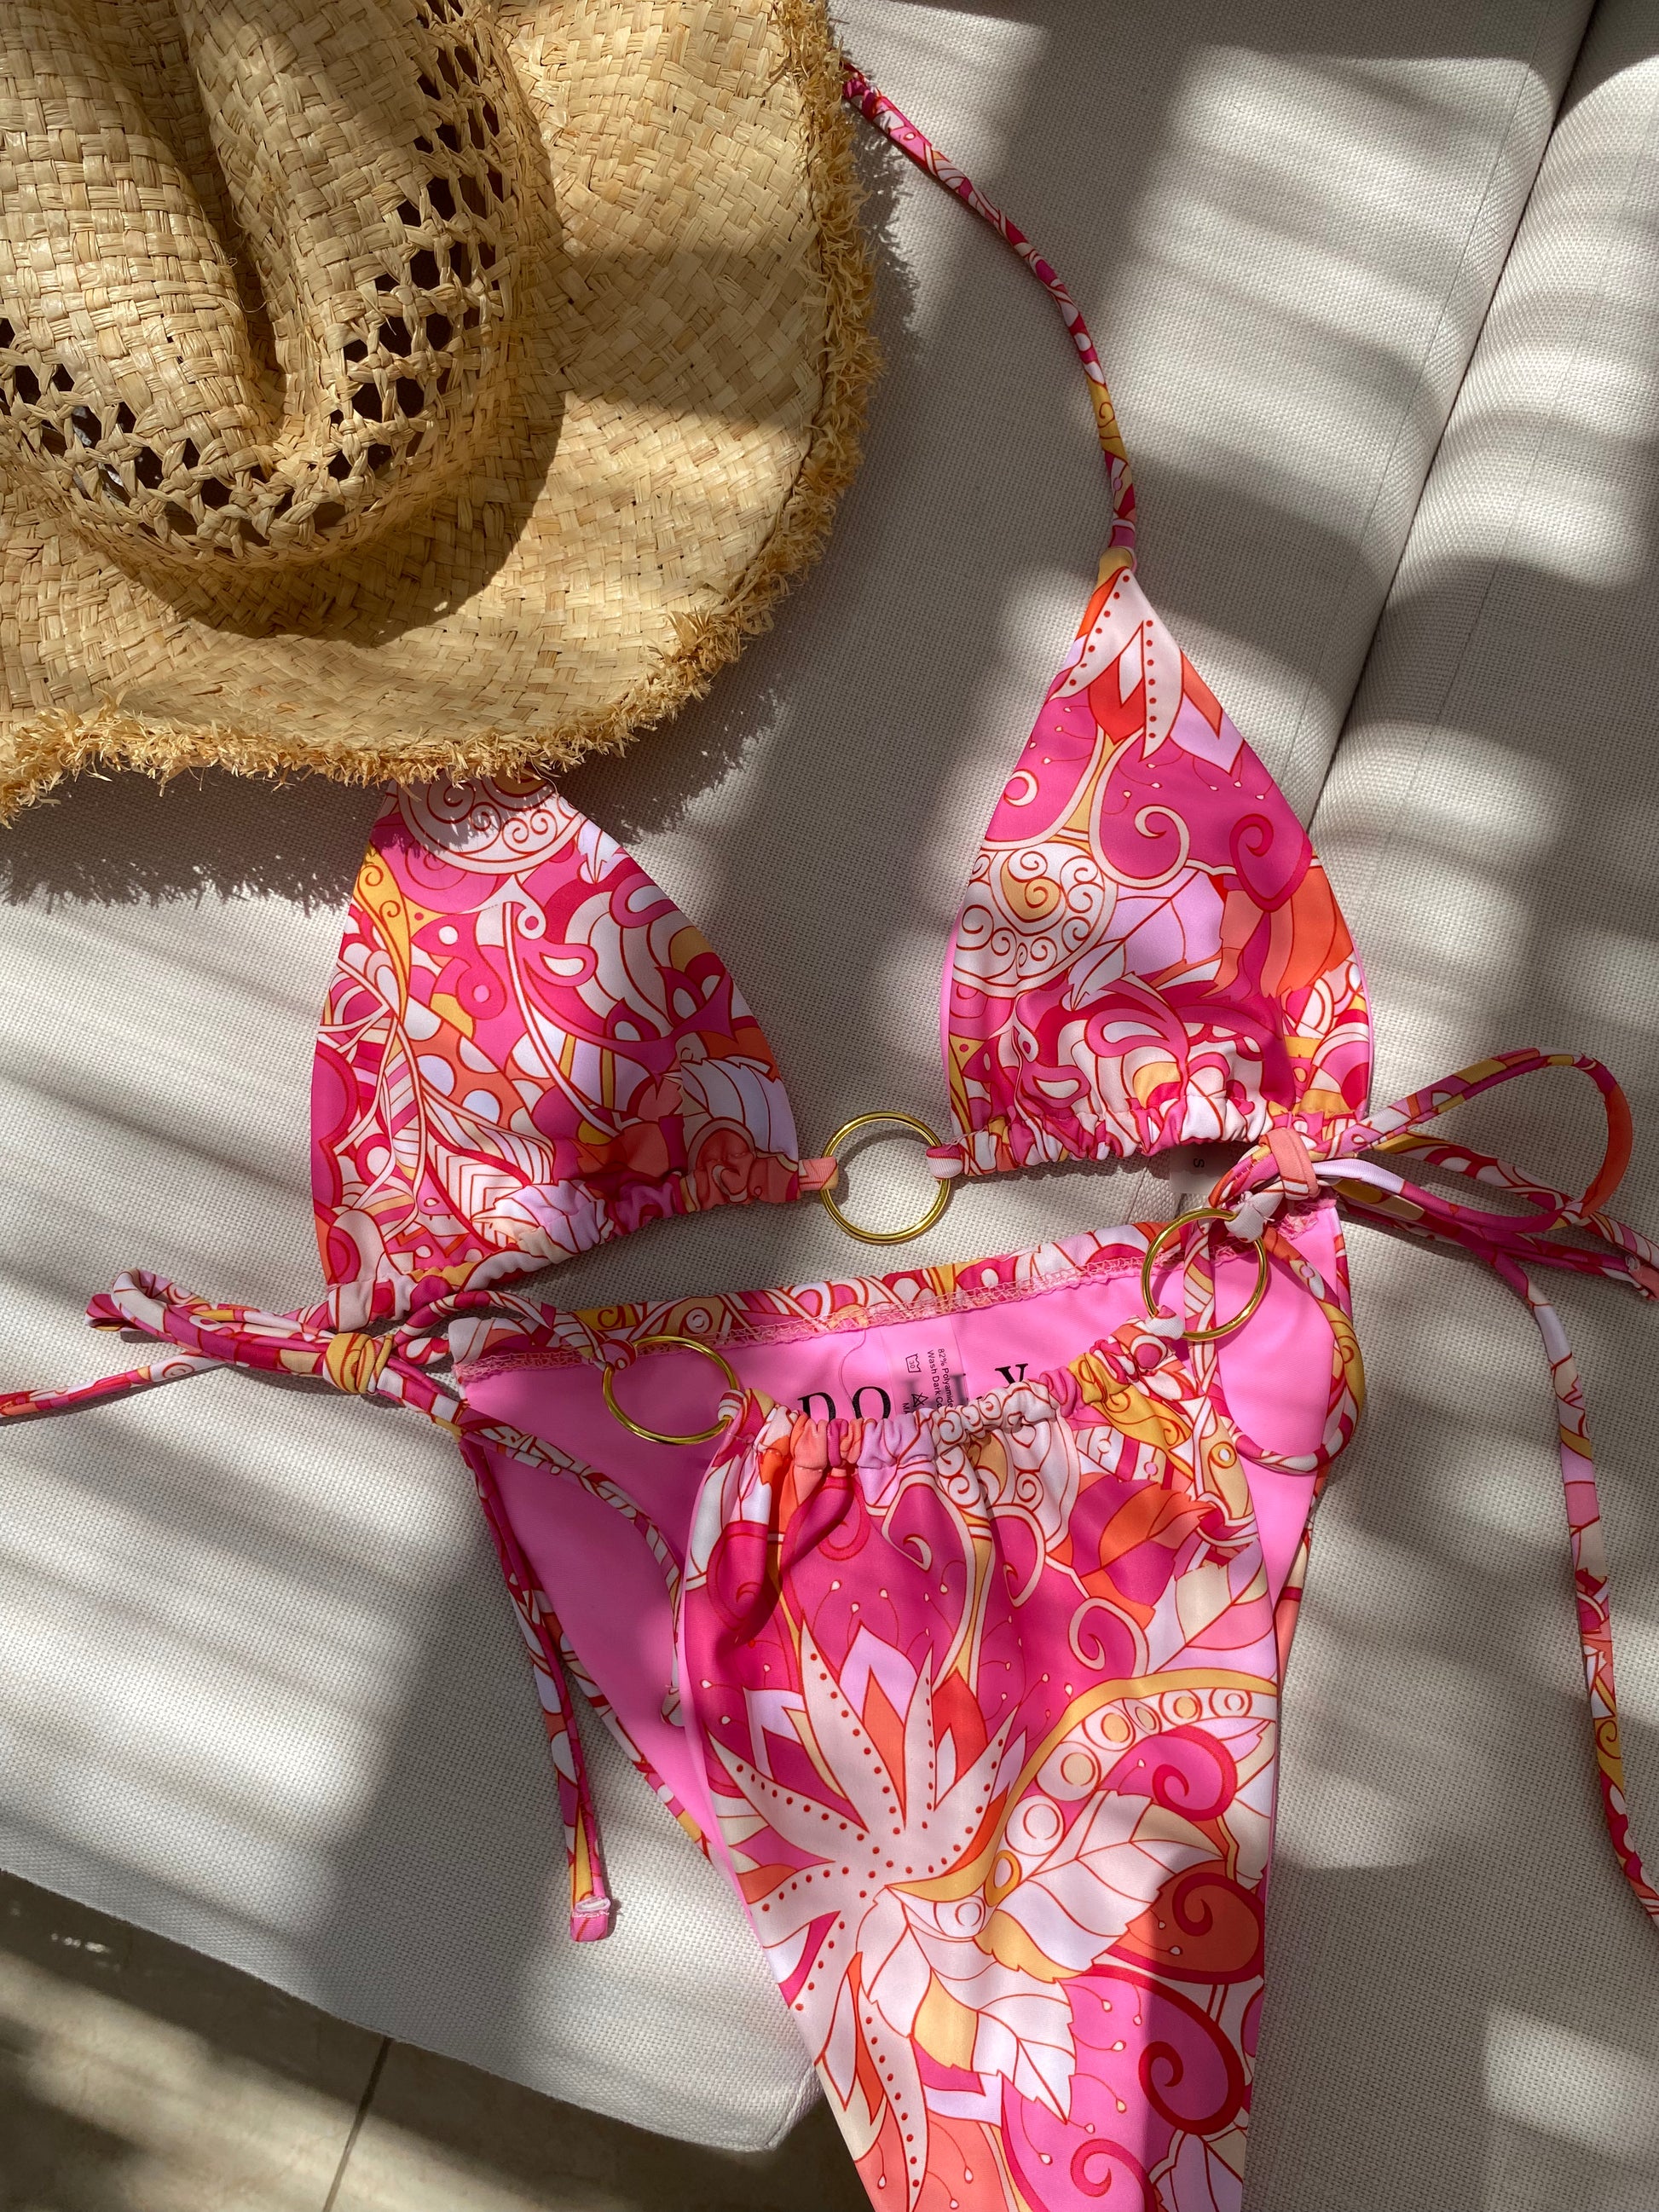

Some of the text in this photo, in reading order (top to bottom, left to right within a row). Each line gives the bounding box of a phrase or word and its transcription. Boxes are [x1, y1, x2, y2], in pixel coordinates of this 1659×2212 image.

[1193, 1158, 1205, 1169] S
[909, 1360, 916, 1369] 30
[927, 1349, 938, 1374] Wash
[932, 1375, 942, 1395] Dark
[938, 1348, 954, 1407] 82% Polyamide
